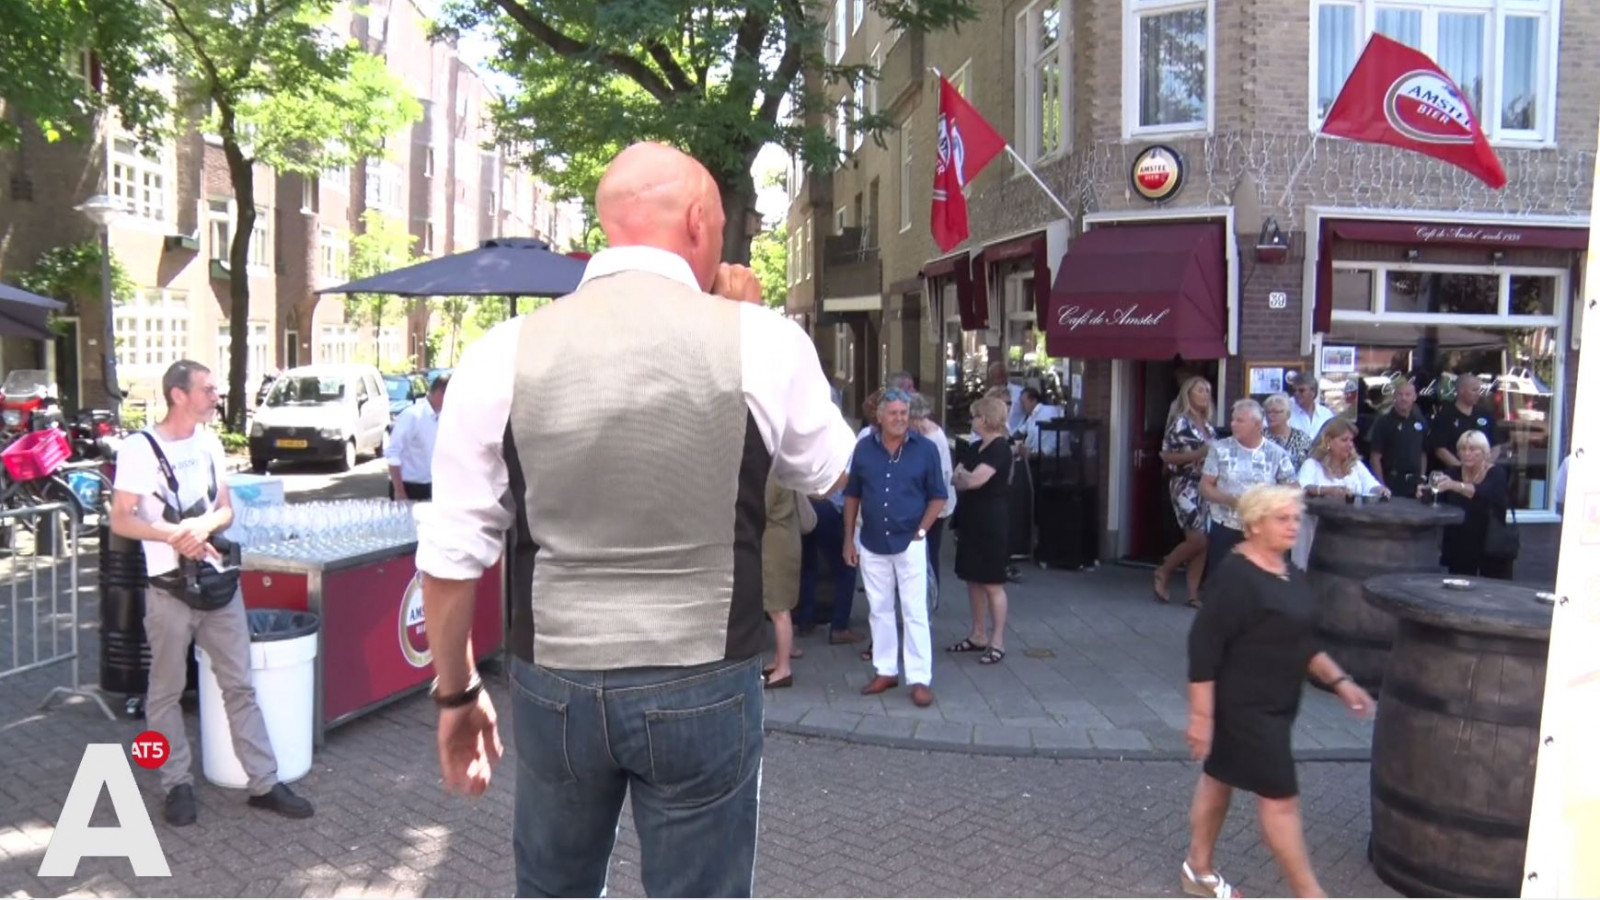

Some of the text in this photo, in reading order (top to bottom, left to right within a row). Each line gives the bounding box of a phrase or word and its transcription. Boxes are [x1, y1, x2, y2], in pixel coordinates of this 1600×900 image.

[1416, 103, 1452, 125] BIER
[1270, 294, 1285, 306] 39
[1058, 304, 1170, 331] Café de Amstel
